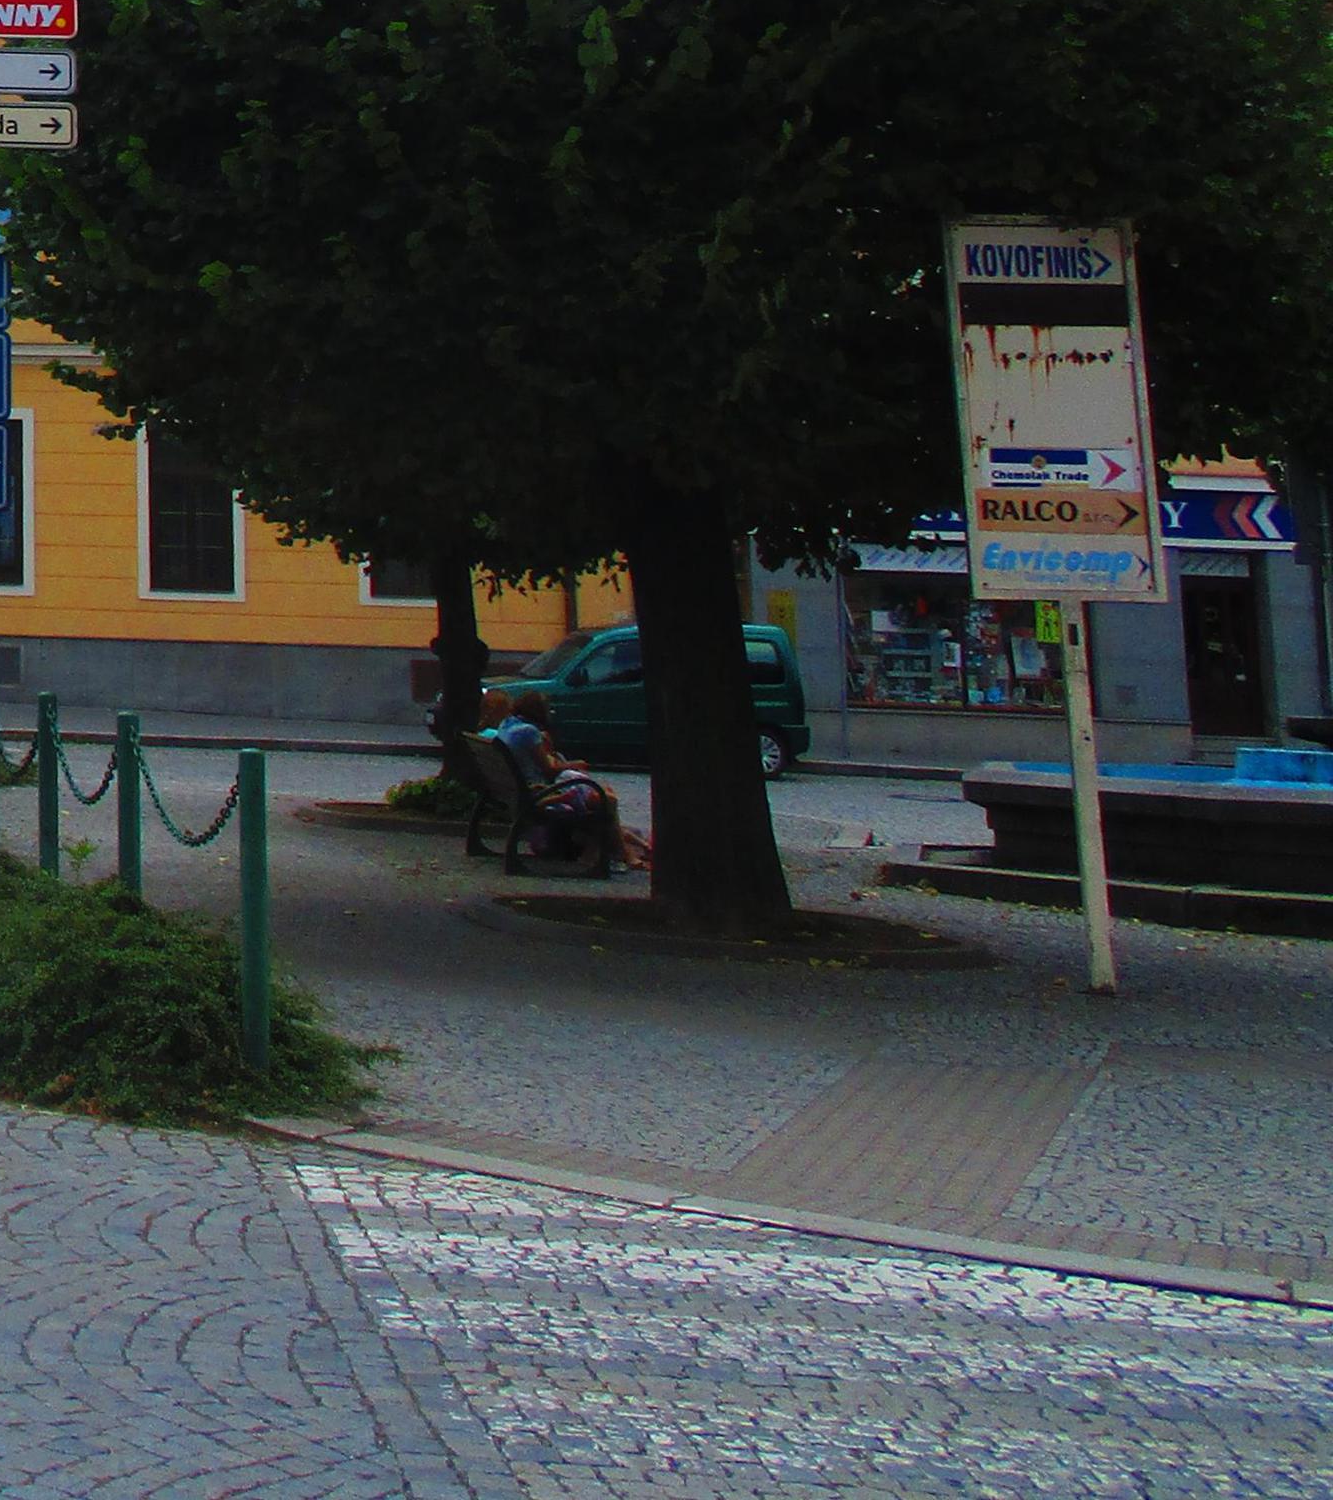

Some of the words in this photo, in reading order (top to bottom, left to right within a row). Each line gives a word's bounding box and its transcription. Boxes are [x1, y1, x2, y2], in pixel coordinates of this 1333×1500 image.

[964, 237, 1092, 279] KOVOFINIŠ
[1055, 471, 1089, 482] Trade
[981, 499, 1078, 522] RALCO
[983, 541, 1133, 584] Envicomp
